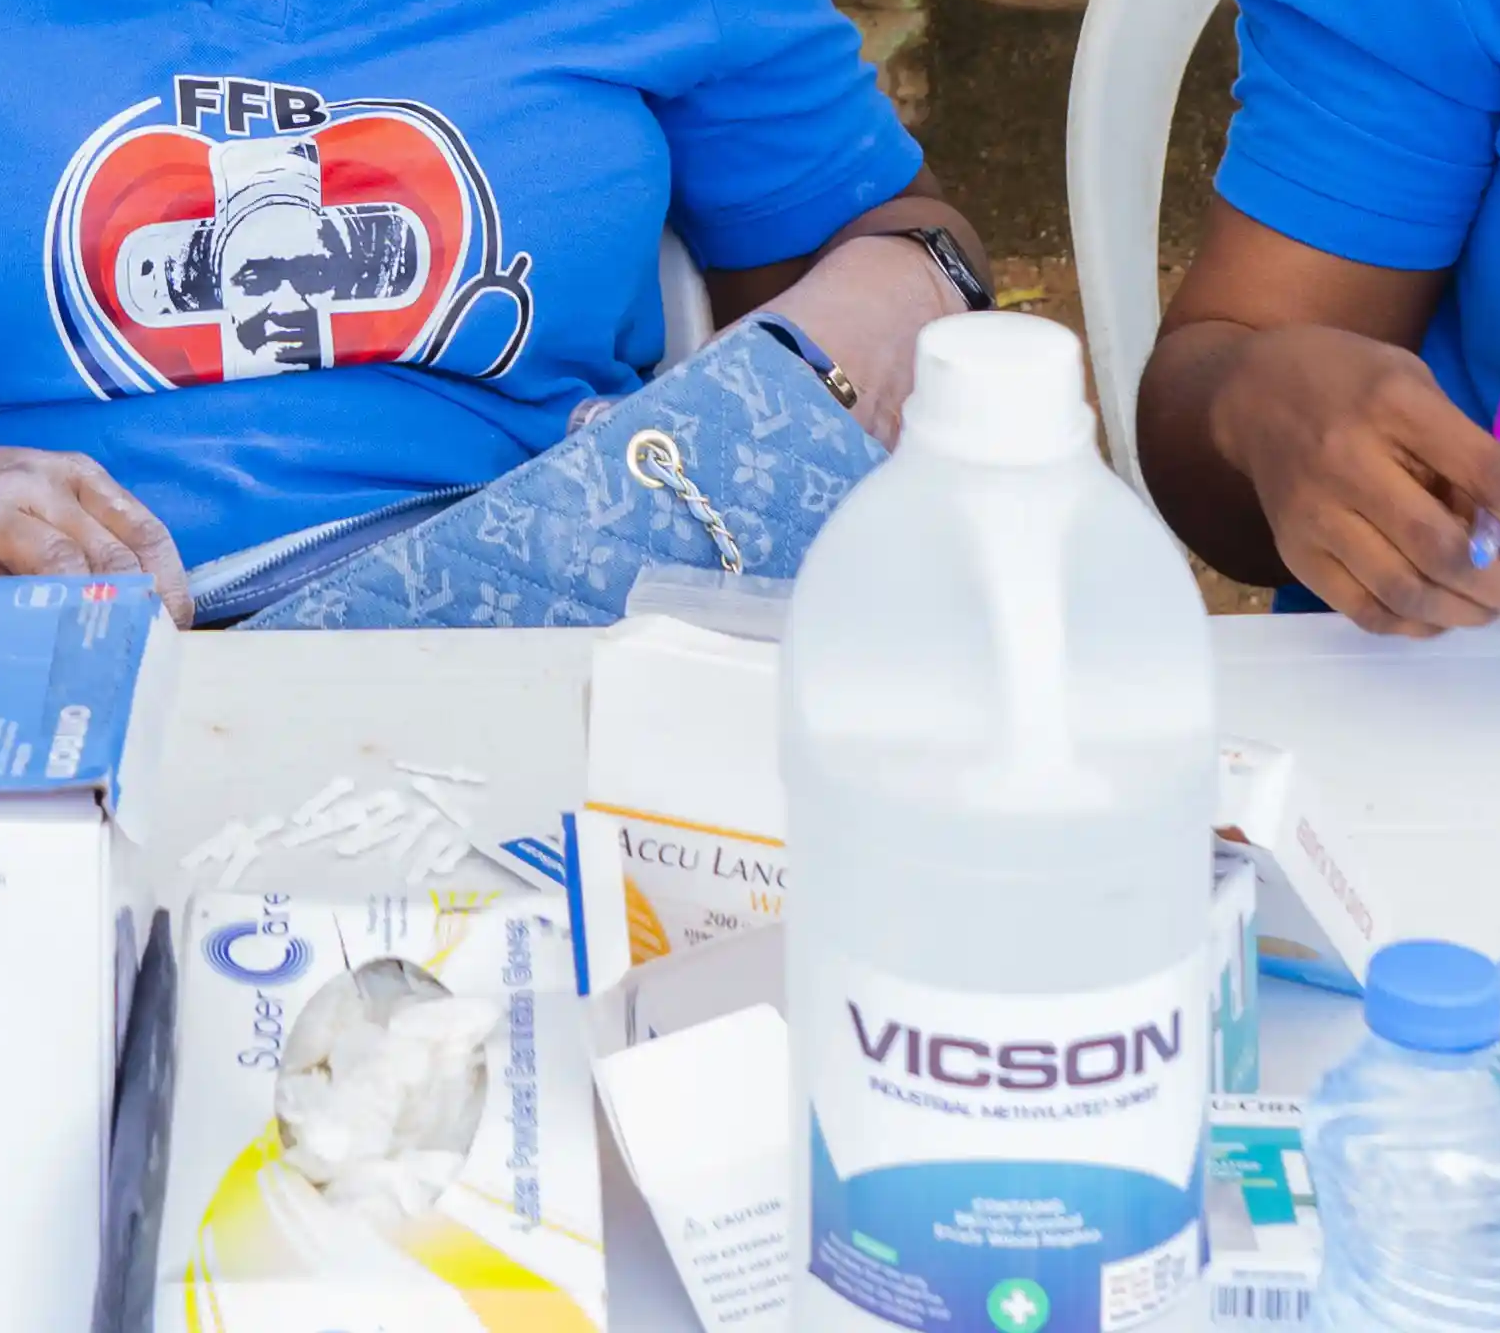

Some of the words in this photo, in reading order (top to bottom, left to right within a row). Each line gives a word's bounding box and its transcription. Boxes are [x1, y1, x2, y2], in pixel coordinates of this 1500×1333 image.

[173, 73, 330, 136] FFB
[618, 826, 700, 871] ACCU
[846, 996, 1183, 1090] VICSON
